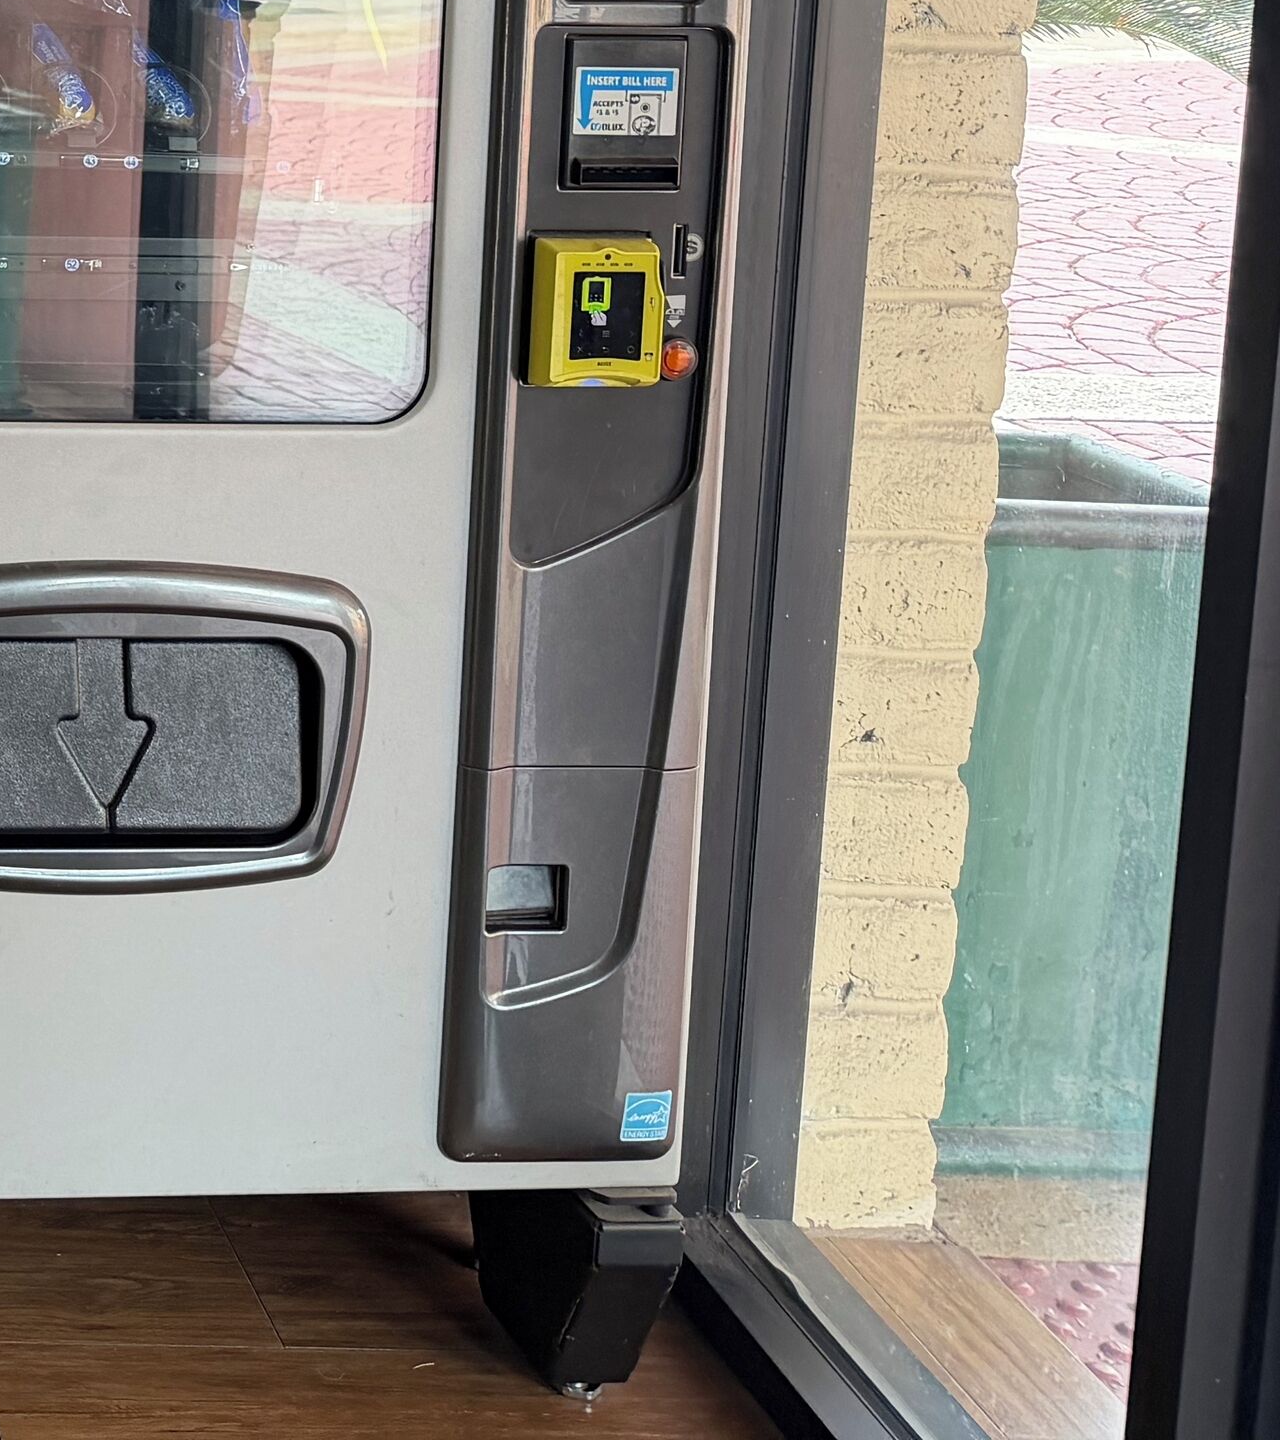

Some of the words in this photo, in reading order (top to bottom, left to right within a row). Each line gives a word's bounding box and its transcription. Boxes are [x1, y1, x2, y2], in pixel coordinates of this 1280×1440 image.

[587, 74, 620, 86] INSERT
[622, 76, 642, 86] BILL
[644, 77, 668, 86] HERE
